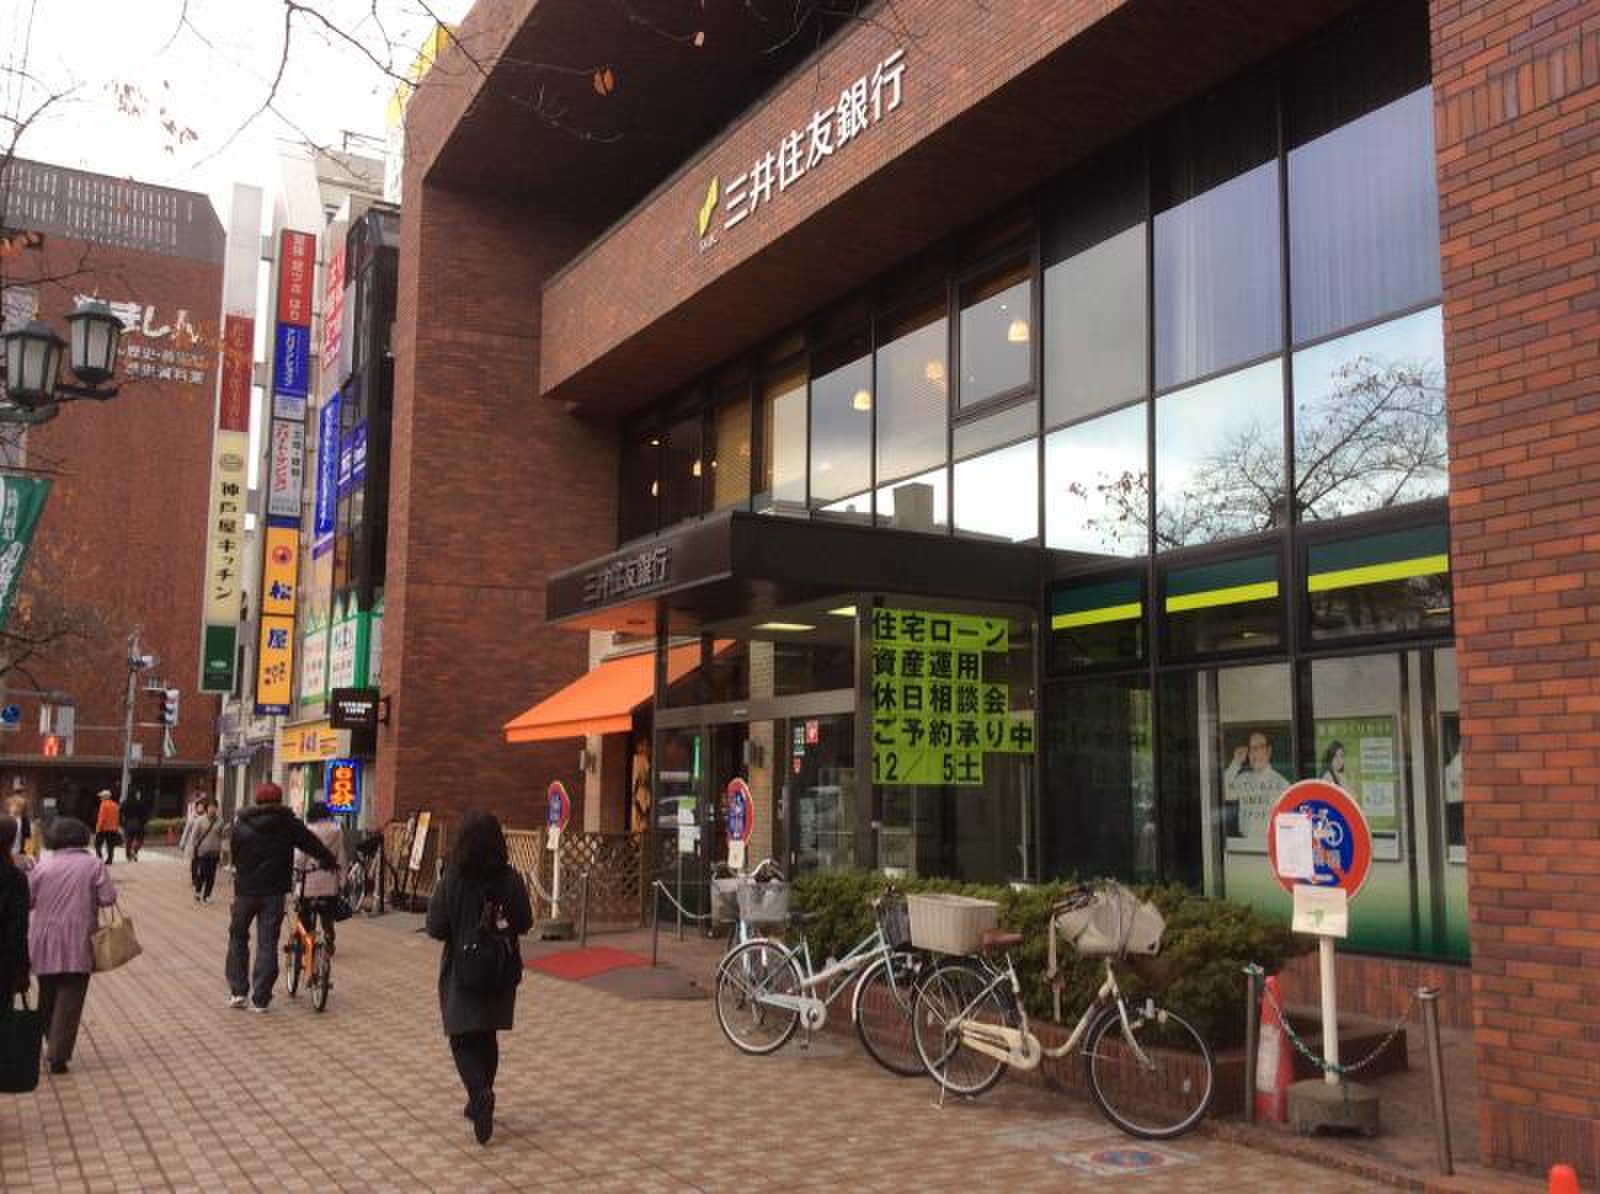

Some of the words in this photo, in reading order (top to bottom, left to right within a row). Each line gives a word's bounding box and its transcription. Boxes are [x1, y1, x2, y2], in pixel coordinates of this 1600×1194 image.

[724, 49, 905, 229] 三井住友銀行
[73, 291, 203, 343] ましん
[215, 481, 241, 600] 神戸屋キッチン
[583, 546, 670, 606] 三井住友銀行
[873, 611, 1005, 647] 住宅ローン
[873, 647, 979, 680] 資産運用
[873, 682, 1006, 714] 休日相談会
[874, 718, 1033, 749] ご予約承り中
